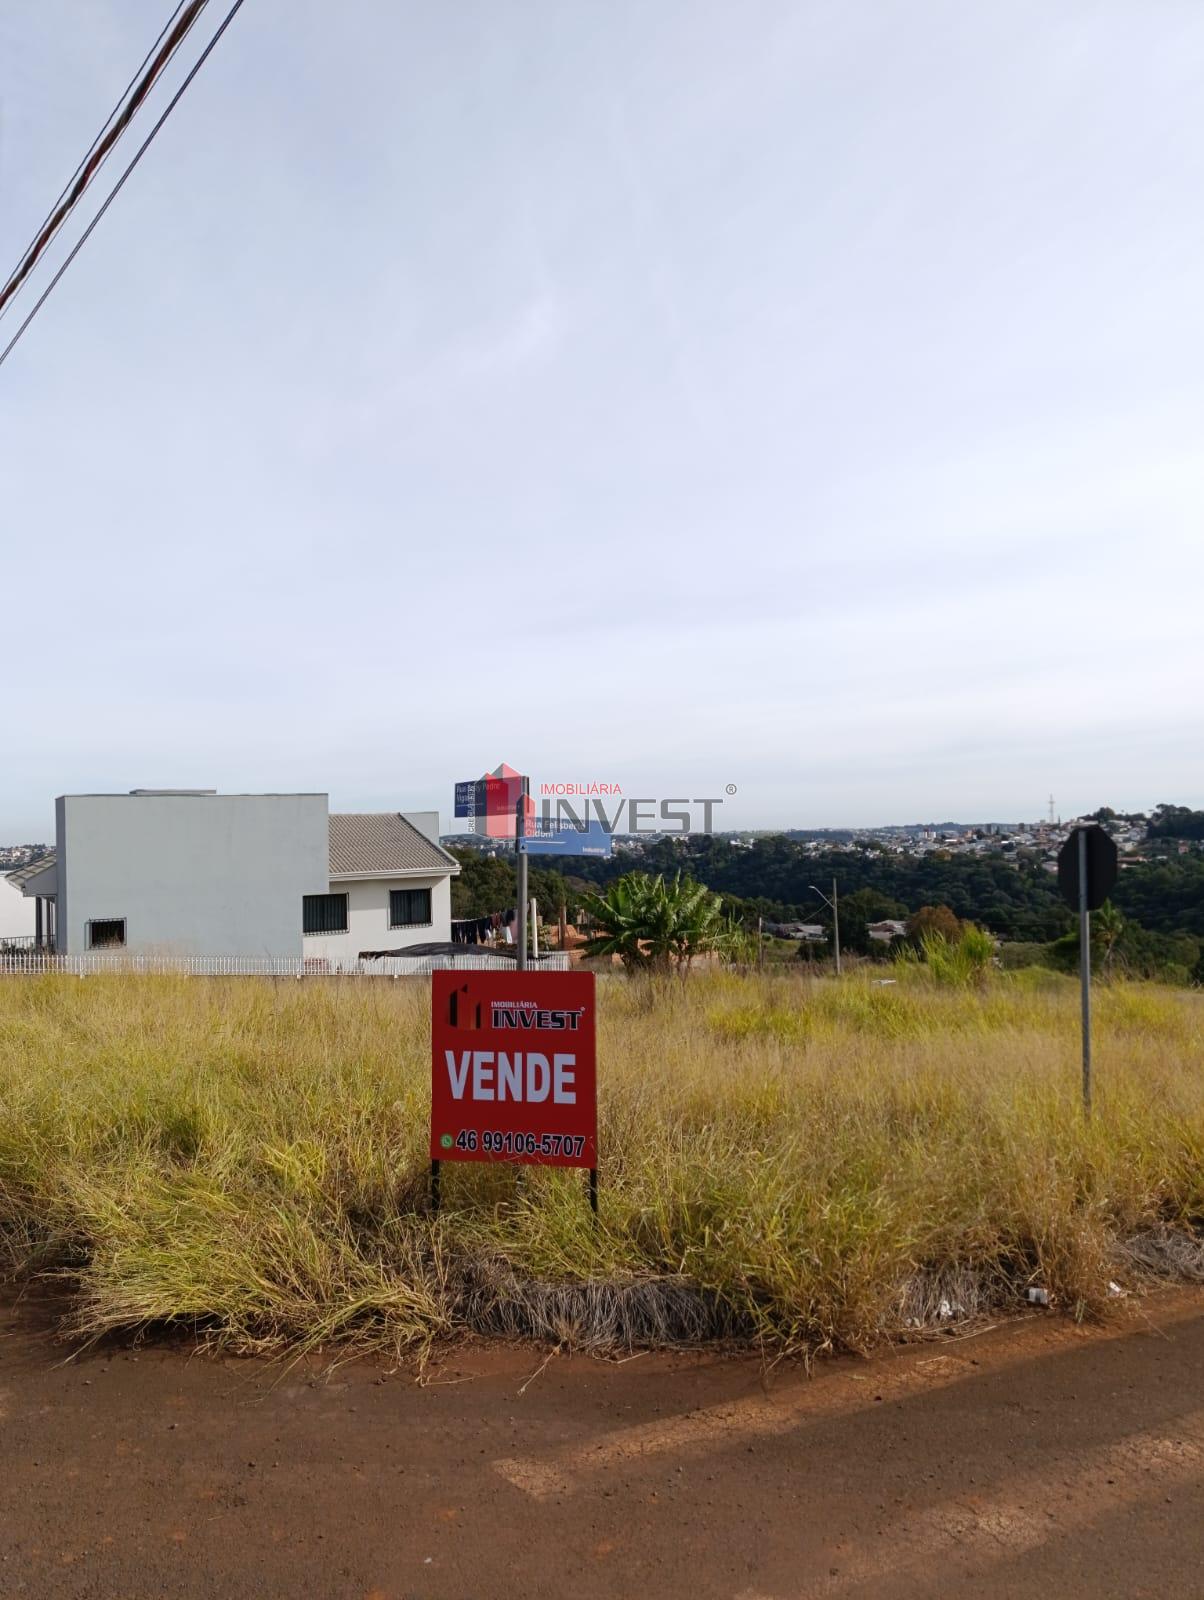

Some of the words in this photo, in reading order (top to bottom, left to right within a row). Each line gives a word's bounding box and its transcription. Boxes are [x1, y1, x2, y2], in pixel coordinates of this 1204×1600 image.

[525, 820, 542, 830] Rua
[491, 1000, 538, 1009] IMOBILIÁRIA
[491, 1009, 582, 1030] INVEST
[445, 1051, 577, 1104] VENDE
[456, 1129, 478, 1151] 46
[482, 1131, 586, 1157] 99106-5707
